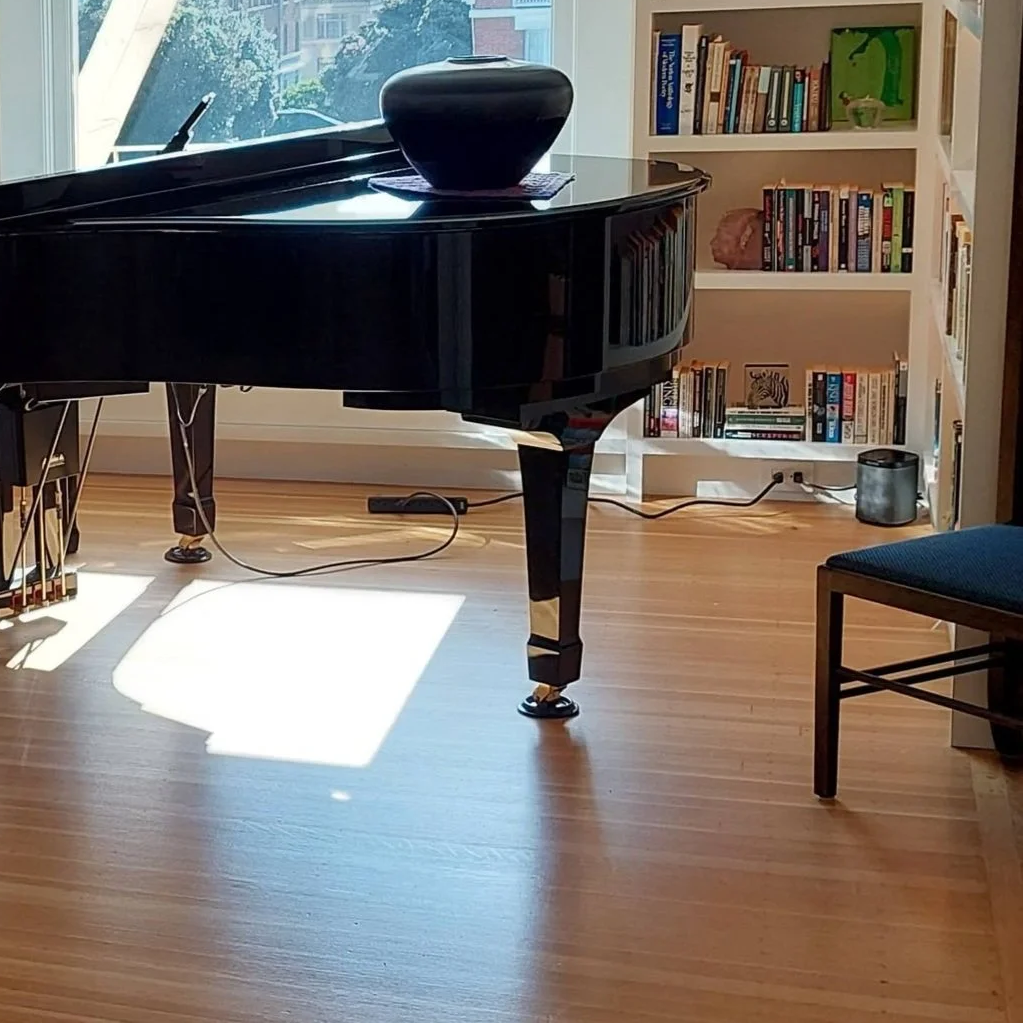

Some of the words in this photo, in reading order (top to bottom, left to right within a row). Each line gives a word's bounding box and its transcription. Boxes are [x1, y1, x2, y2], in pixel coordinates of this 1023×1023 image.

[661, 58, 669, 79] Modern
[667, 61, 676, 81] Norton
[659, 80, 668, 97] Poetry
[665, 82, 675, 109] Anthology
